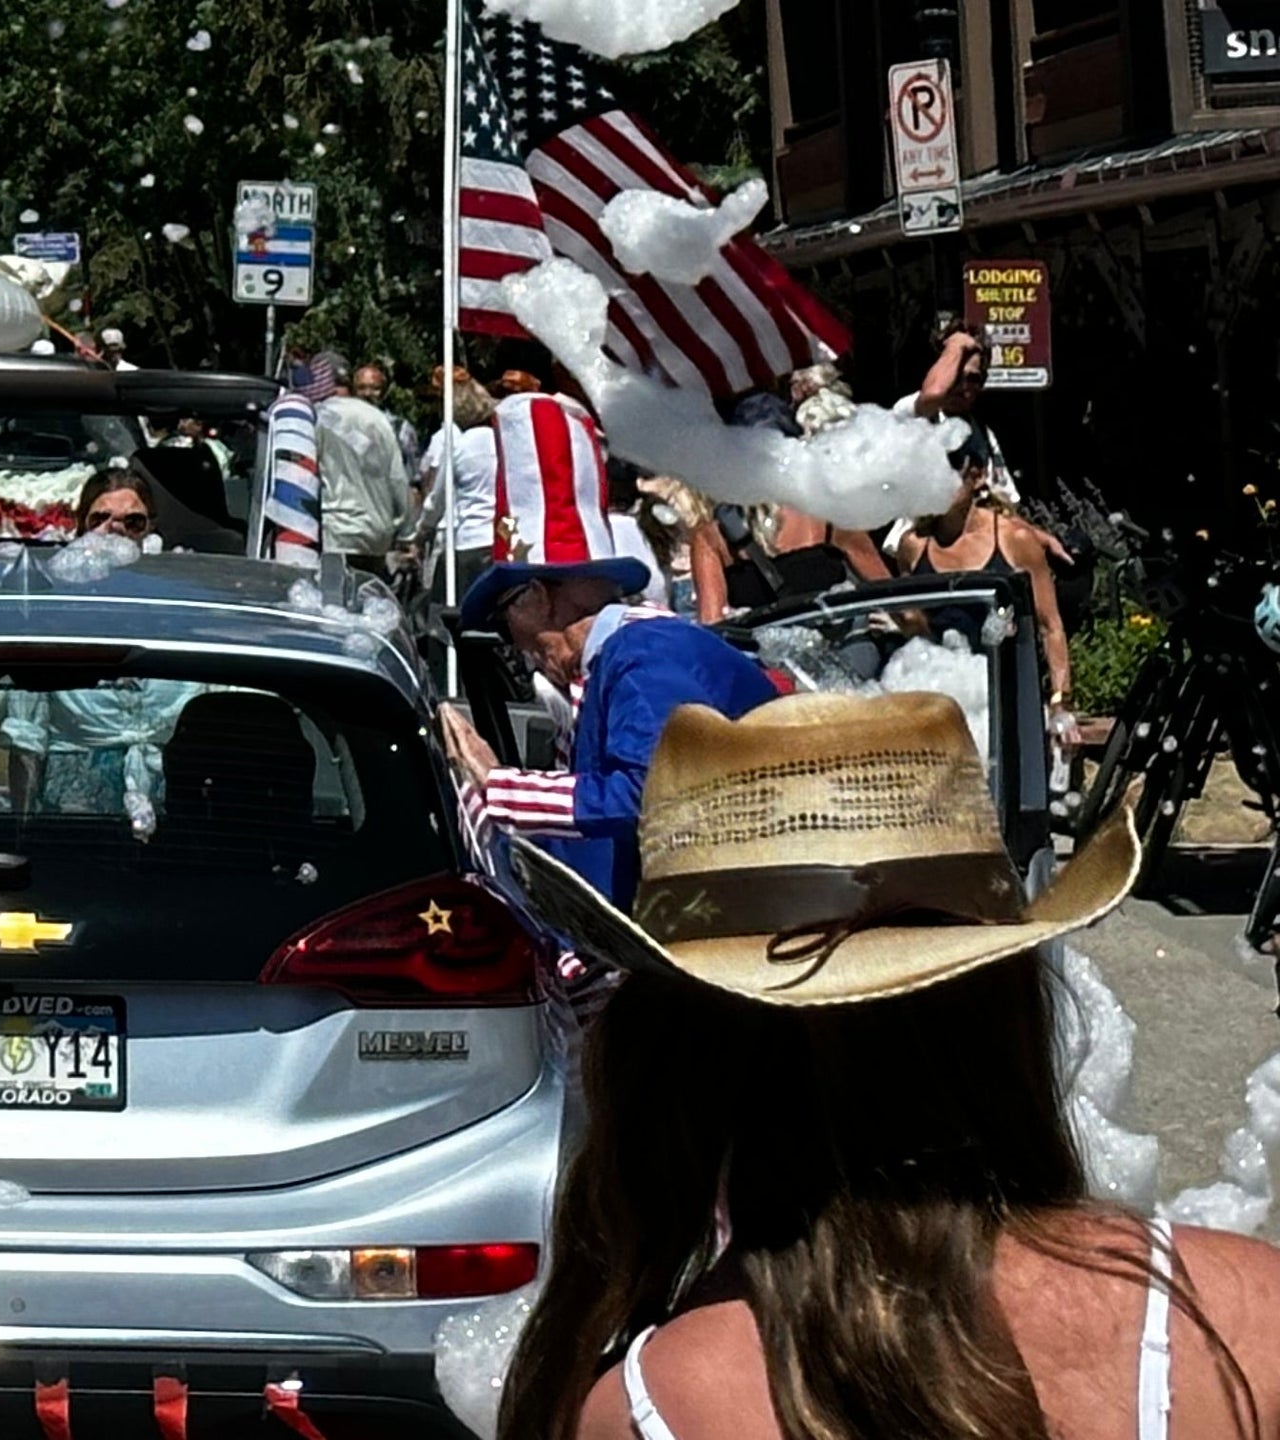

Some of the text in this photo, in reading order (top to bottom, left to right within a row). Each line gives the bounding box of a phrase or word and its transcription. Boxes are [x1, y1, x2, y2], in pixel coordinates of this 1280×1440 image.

[263, 268, 285, 296] 9
[968, 268, 1042, 285] LODGING
[975, 287, 1038, 303] SHUTTLE
[988, 306, 1026, 322] STOP
[41, 1026, 113, 1079] Y14
